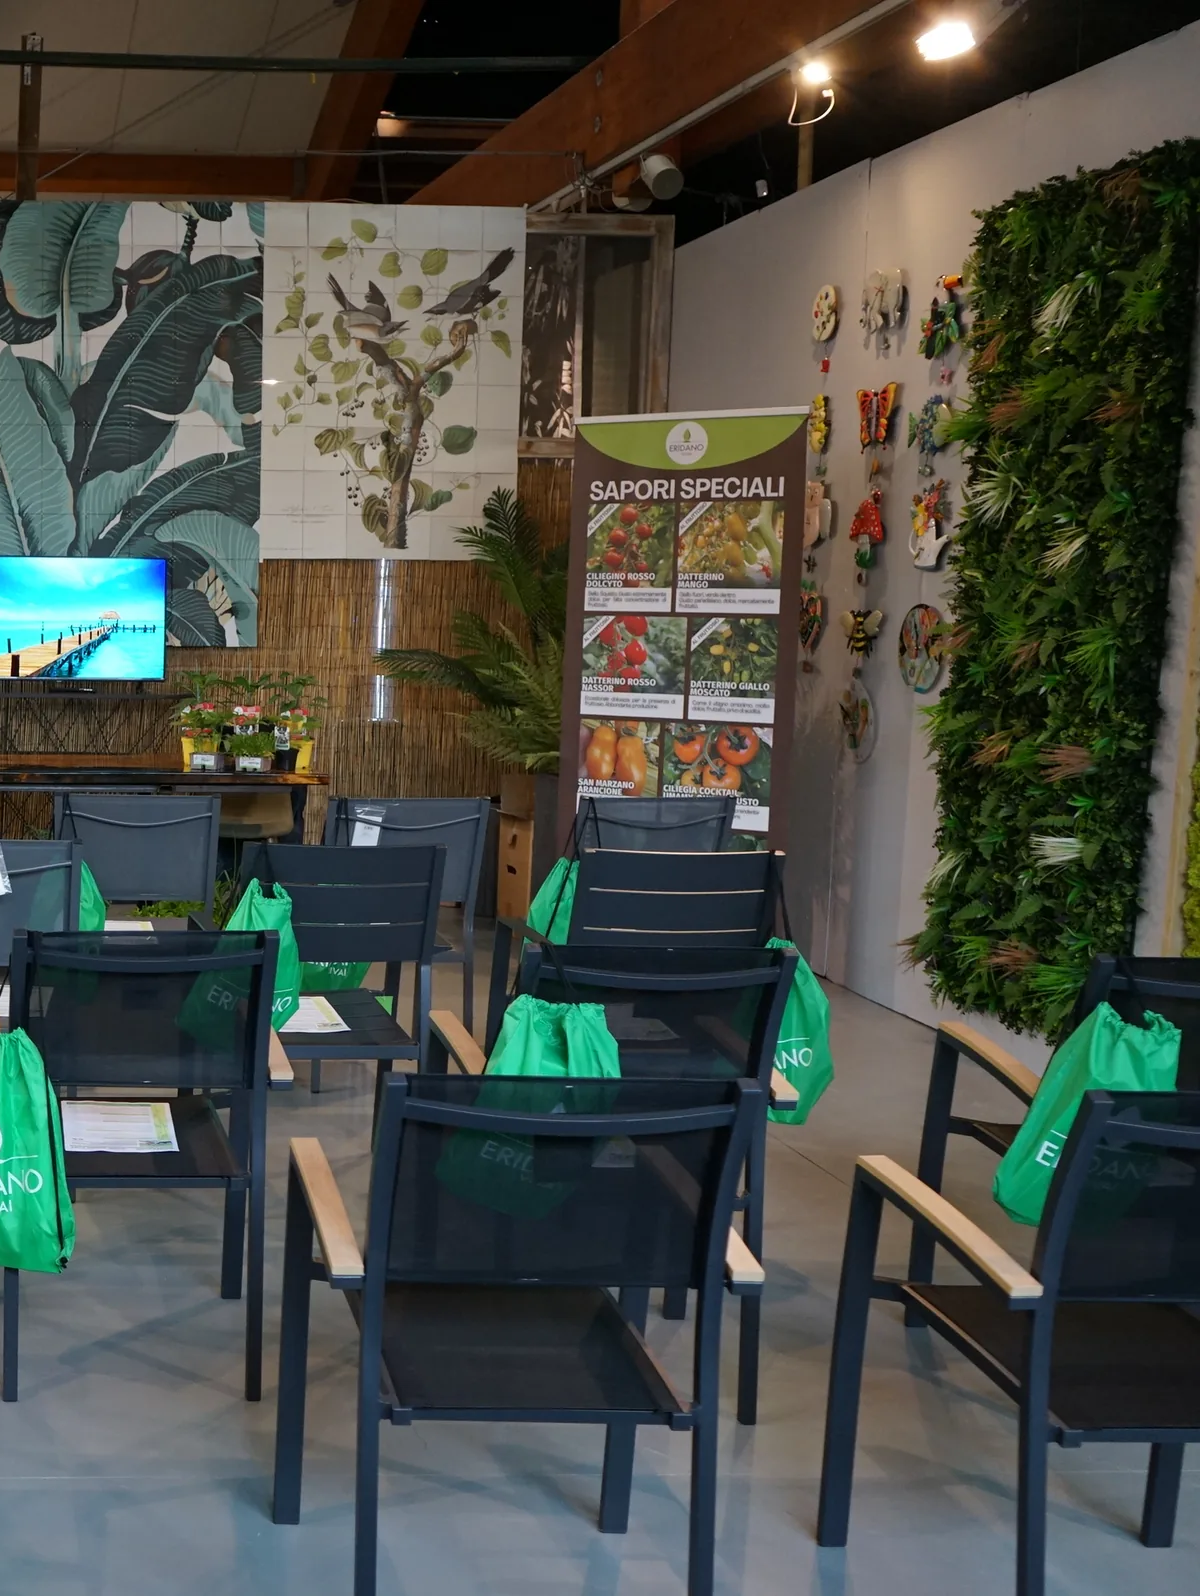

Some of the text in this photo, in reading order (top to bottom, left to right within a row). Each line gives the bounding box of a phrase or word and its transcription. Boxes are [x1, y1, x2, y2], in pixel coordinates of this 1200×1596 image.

[669, 444, 704, 452] ERIDANO
[590, 476, 785, 501] SAPORI SPECIALI
[586, 573, 656, 581] CILIEGINO ROSSO
[677, 573, 724, 581] DATTERINO
[586, 580, 623, 588] DOLCYTO
[582, 677, 656, 687] DATTERINO ROSSO
[690, 680, 770, 691] DATTERINO GIALLO
[582, 684, 614, 692] NASSOR
[690, 688, 730, 697] MOSCATO
[577, 778, 634, 789] SAN MARZANO
[577, 786, 622, 795] ARANCIONE
[663, 785, 738, 797] CILIEGIA COCKTAIL
[736, 798, 759, 806] USTO
